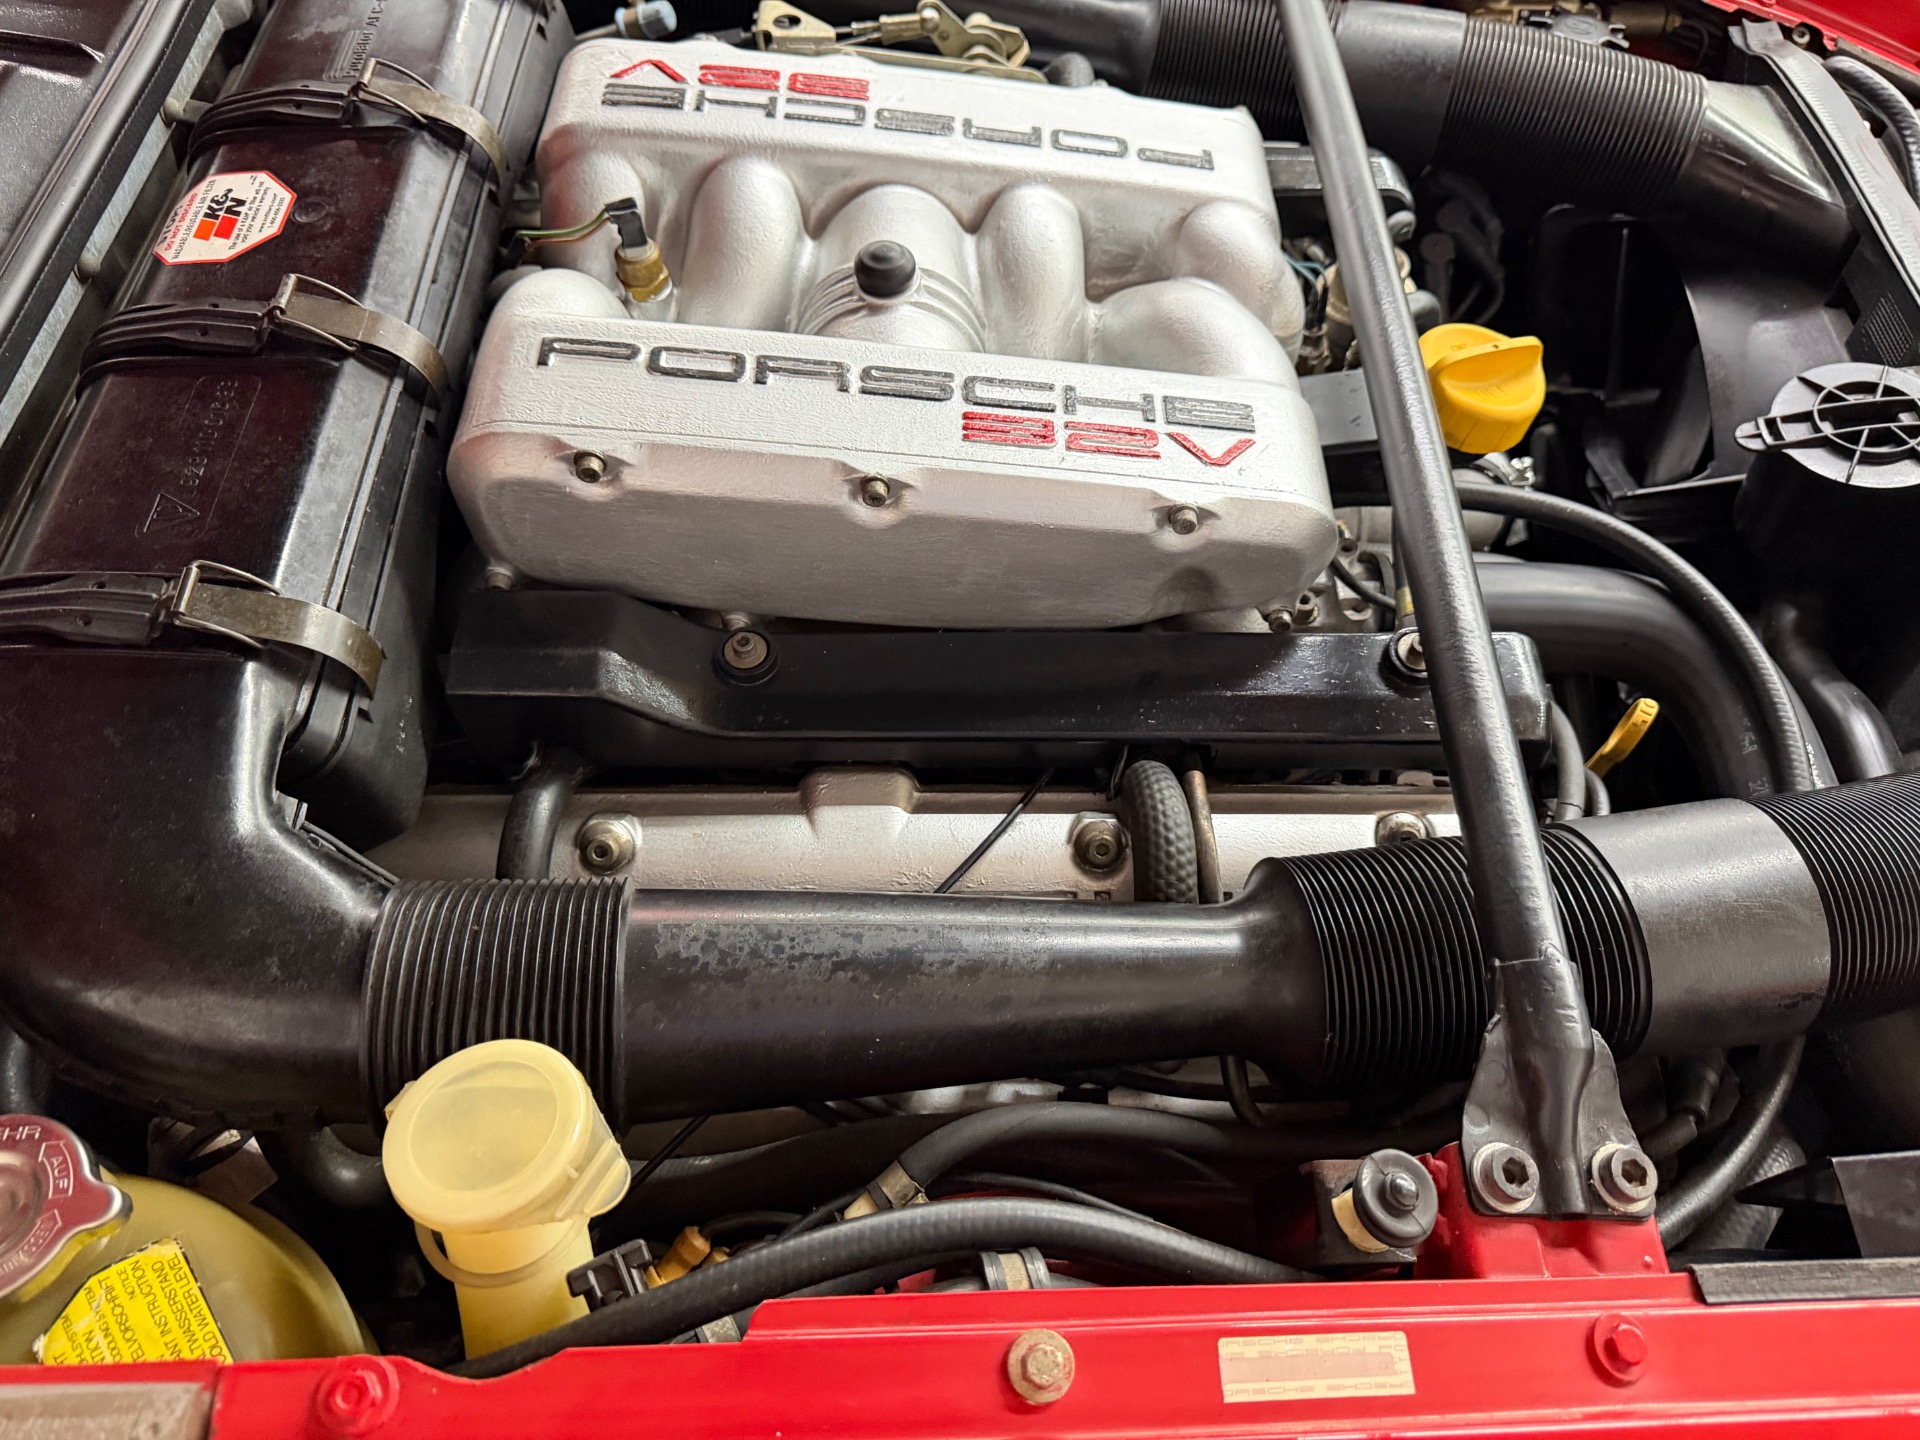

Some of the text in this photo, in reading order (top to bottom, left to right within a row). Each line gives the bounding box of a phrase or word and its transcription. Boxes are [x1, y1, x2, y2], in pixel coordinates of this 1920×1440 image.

[602, 83, 1214, 171] PORSCHE
[204, 179, 217, 195] FILTER
[165, 192, 198, 252] DO NOT DISCARD
[228, 239, 238, 250] The
[537, 336, 1257, 431] PORSCHE
[962, 411, 1256, 467] 32V
[50, 1155, 68, 1190] AUF
[116, 1267, 137, 1301] NOTICE
[167, 1252, 191, 1288] LEVEL
[129, 1259, 172, 1338] INSTRUCTION
[182, 1287, 210, 1332] WATER
